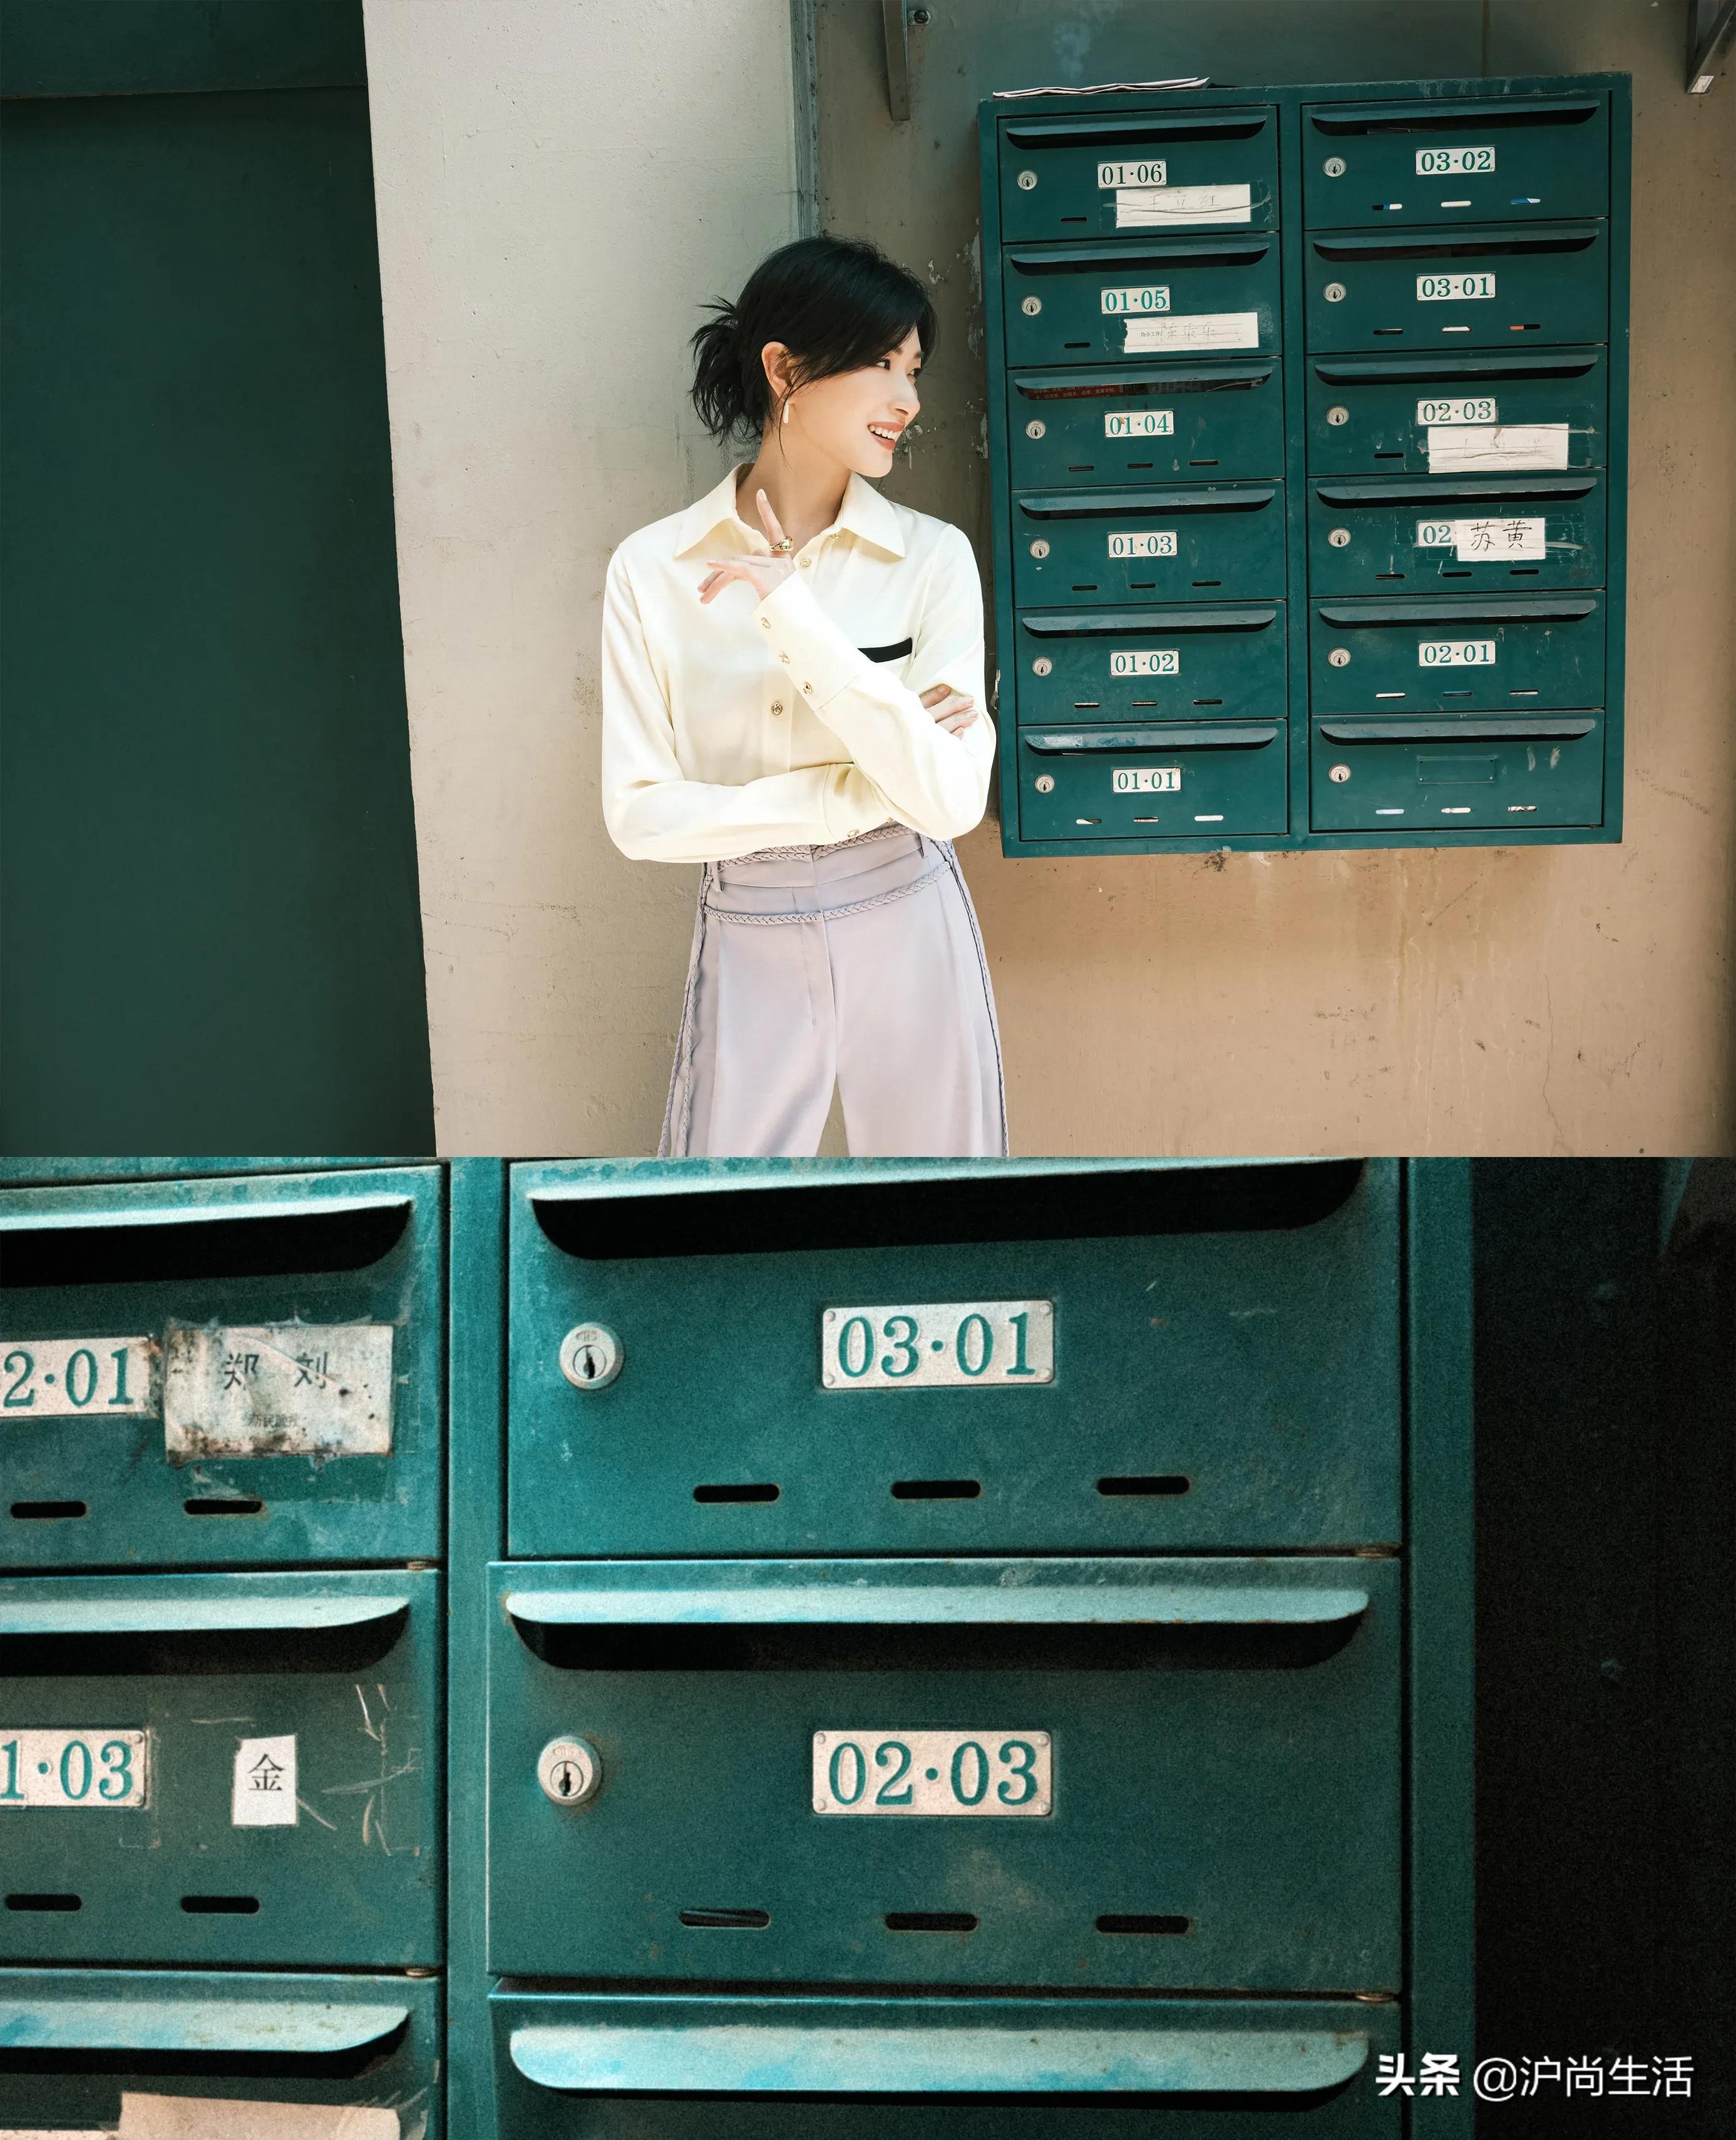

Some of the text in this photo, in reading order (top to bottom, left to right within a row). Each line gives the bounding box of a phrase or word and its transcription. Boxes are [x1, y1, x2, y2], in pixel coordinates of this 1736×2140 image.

[1422, 151, 1490, 172] 03·02
[1102, 164, 1162, 185] 01·06
[1422, 277, 1489, 297] 03·01
[1106, 290, 1167, 311] 01·05
[1424, 401, 1491, 421] 02·03
[1110, 414, 1169, 435] 01·04
[1113, 536, 1171, 555] 01·03
[1116, 654, 1174, 673] 01·02
[1425, 644, 1489, 663] 02·01
[1118, 772, 1174, 790] 01·01
[839, 1312, 1035, 1377] 03·01
[249, 1754, 284, 1791] 金
[829, 1740, 1038, 1806] 02·03
